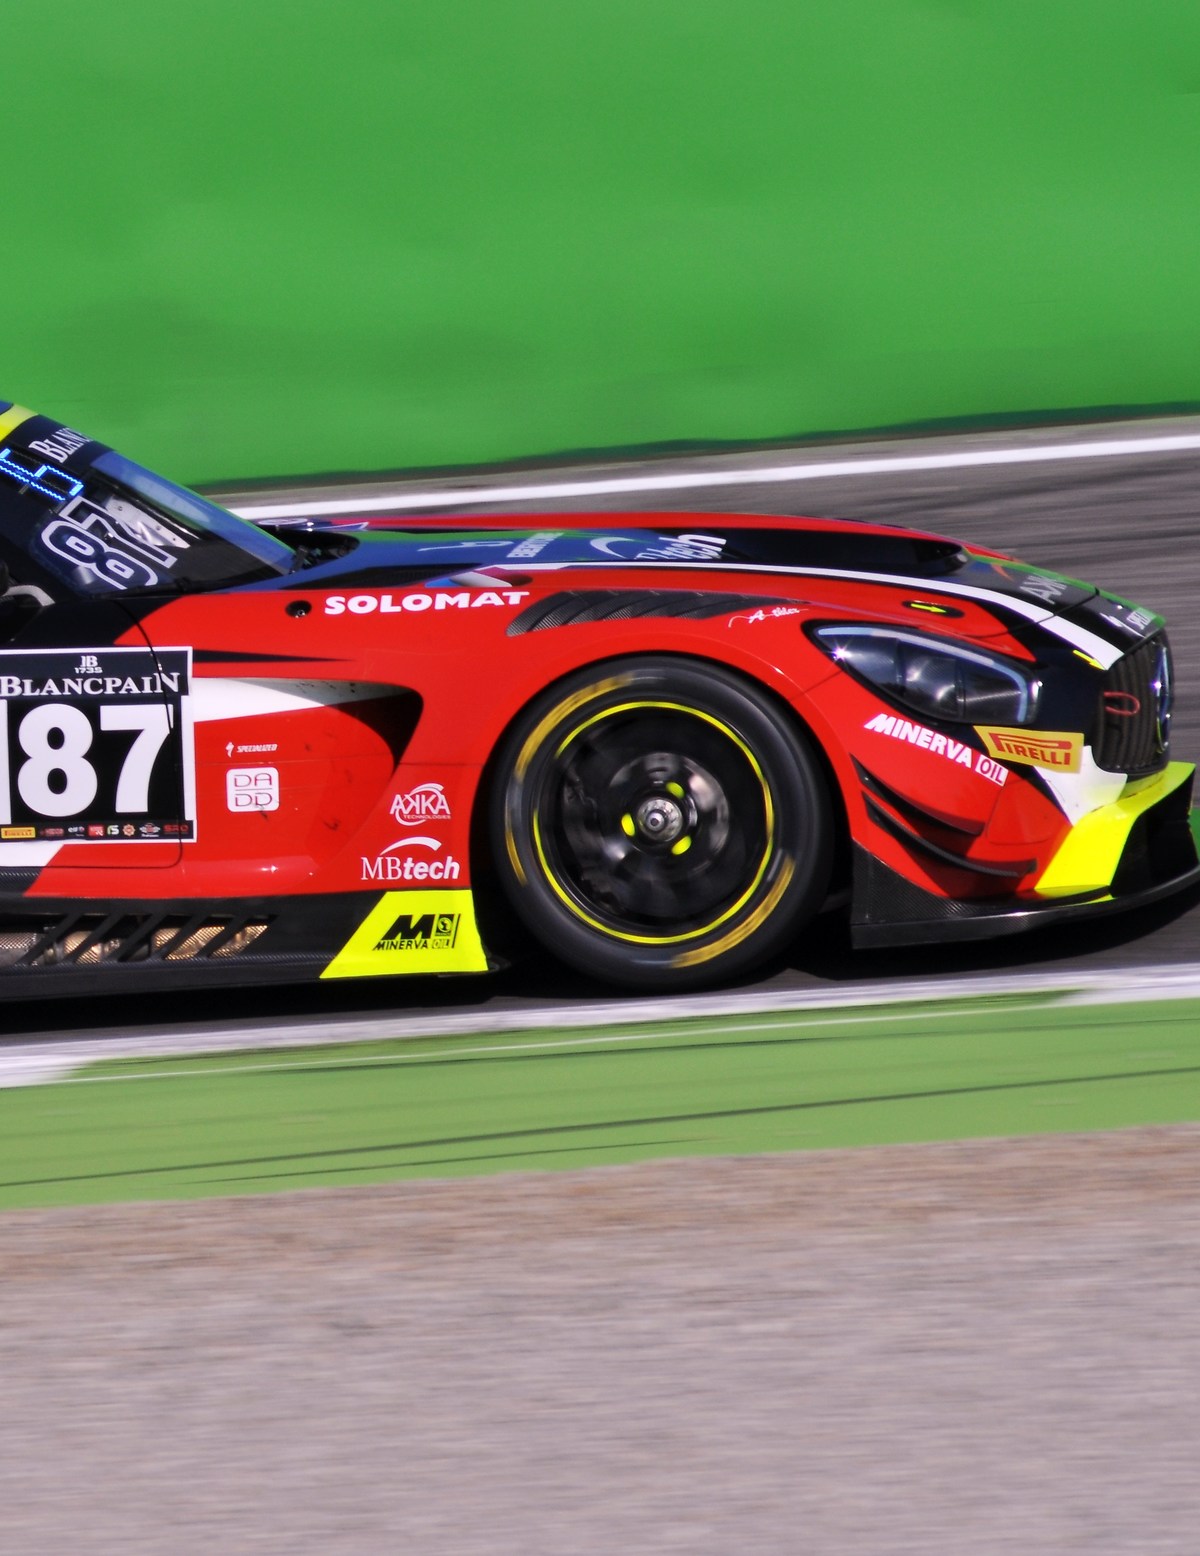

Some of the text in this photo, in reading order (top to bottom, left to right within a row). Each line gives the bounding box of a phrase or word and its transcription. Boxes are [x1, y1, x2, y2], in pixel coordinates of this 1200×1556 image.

[41, 495, 178, 590] 87
[324, 591, 530, 615] SOLOMAT
[864, 713, 971, 768] MINERVA
[988, 732, 1073, 765] PIRELLI
[17, 703, 174, 817] 87
[361, 856, 460, 880] MBtech
[372, 940, 429, 951] MINERVA
